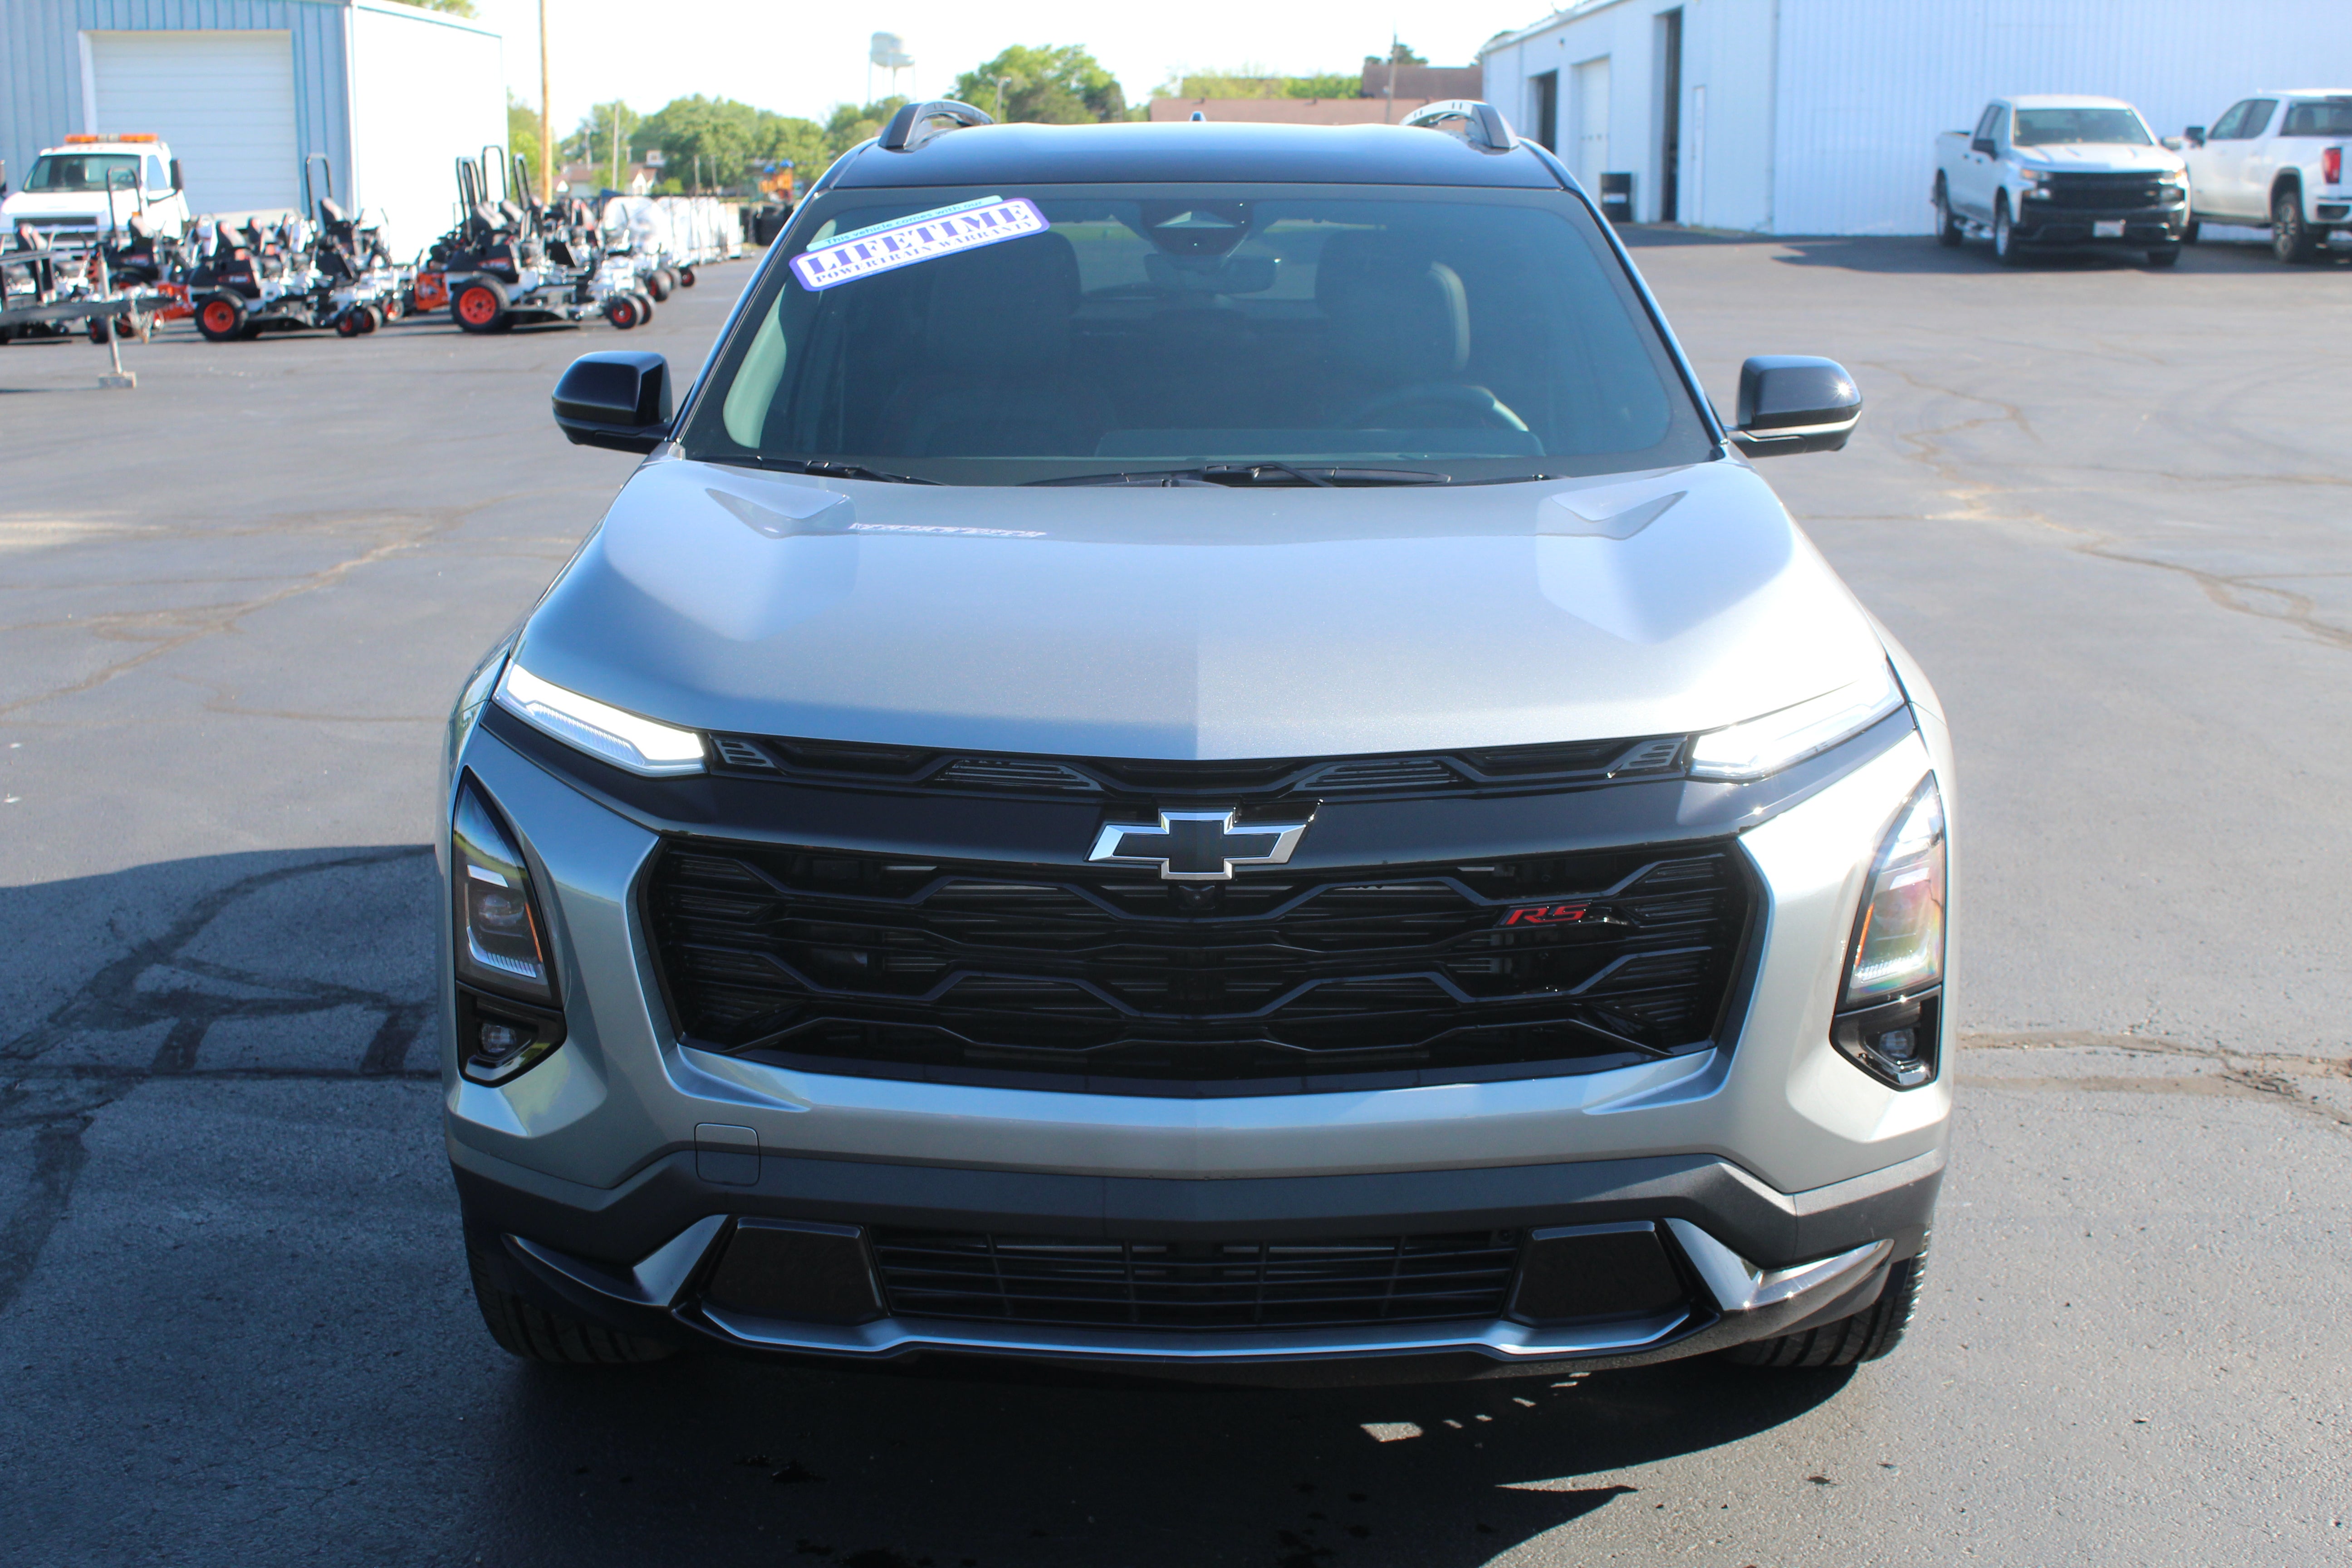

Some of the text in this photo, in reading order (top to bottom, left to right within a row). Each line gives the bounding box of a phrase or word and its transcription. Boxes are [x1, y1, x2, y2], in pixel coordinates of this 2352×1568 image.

[805, 205, 1029, 275] LIFETIME
[824, 235, 850, 245] This
[853, 223, 893, 237] vehicle
[896, 213, 933, 225] comes
[935, 205, 961, 215] with
[815, 245, 932, 283] POWERTRAIN
[938, 221, 1032, 247] WARRANTY
[1505, 904, 1589, 925] RS
